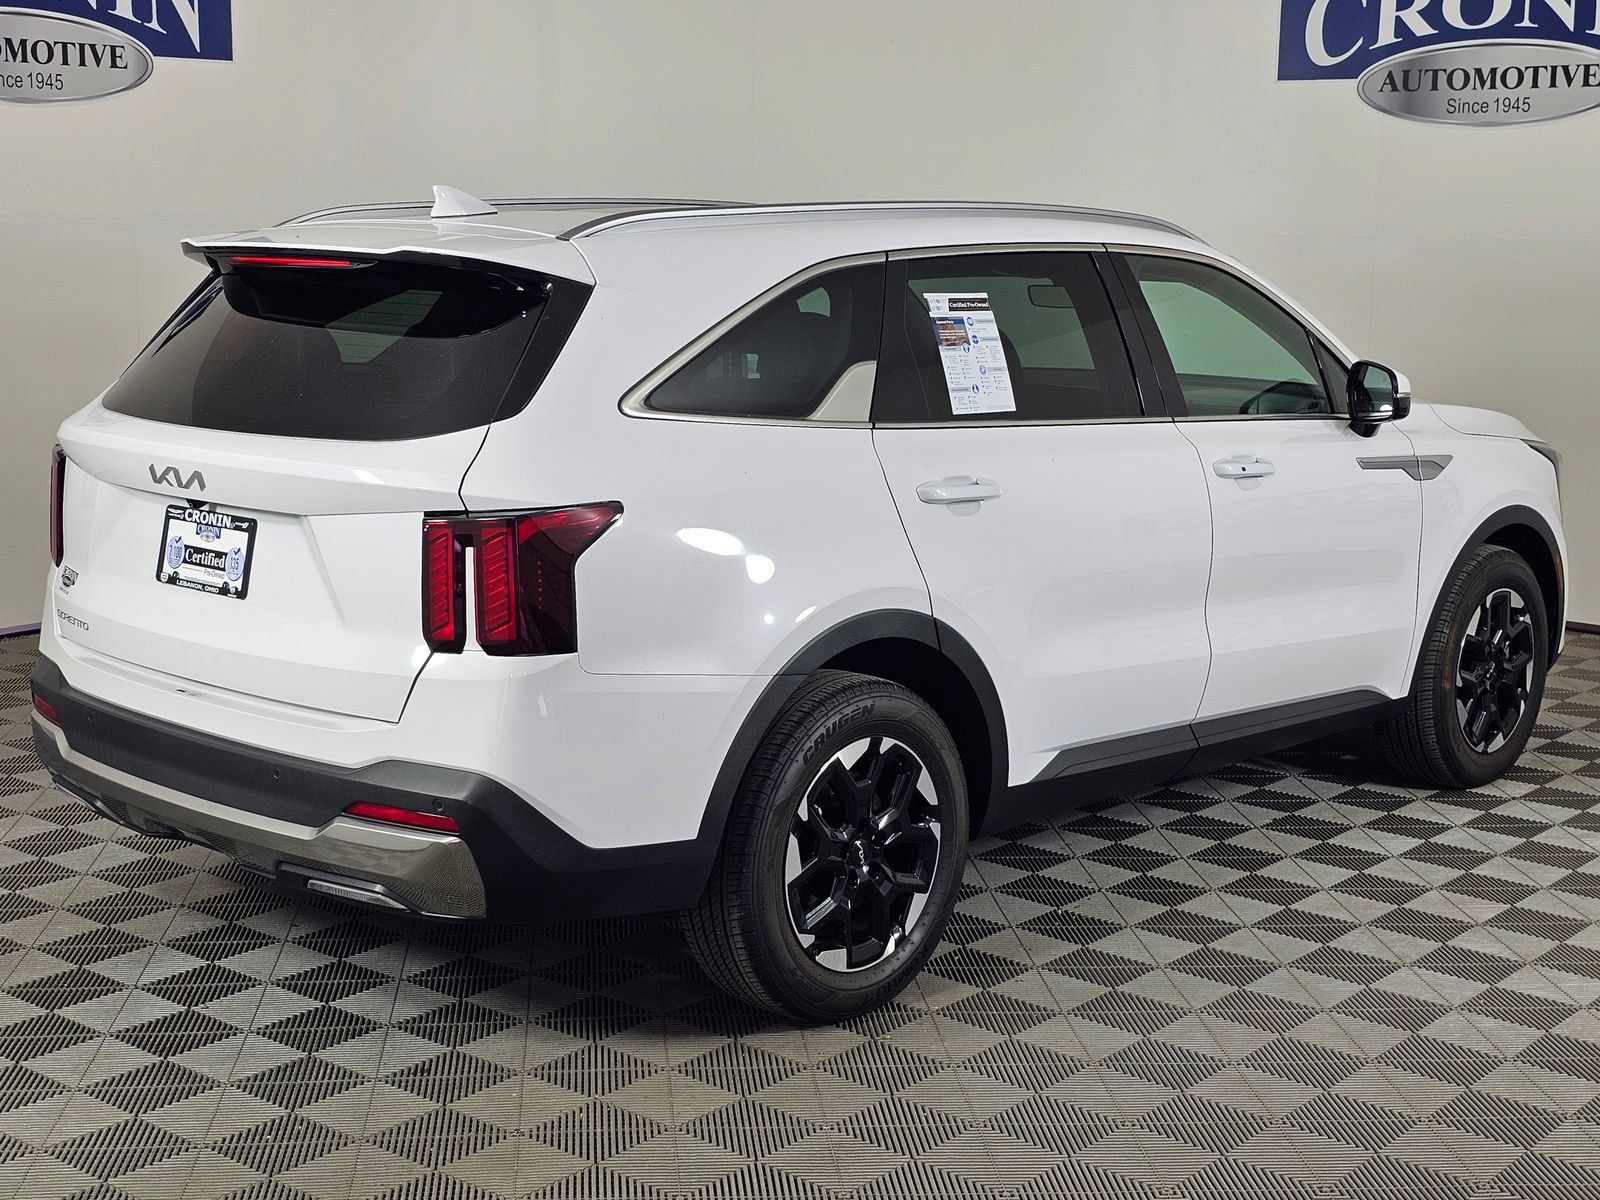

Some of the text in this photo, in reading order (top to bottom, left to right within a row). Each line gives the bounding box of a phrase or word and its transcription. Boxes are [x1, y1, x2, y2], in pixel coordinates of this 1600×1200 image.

[0, 36, 128, 70] MOTIVE
[27, 72, 64, 90] 1945
[1377, 63, 1600, 93] AUTOMOTIVE
[1446, 96, 1531, 114] Since 1945
[184, 508, 232, 528] CRONIN
[185, 548, 225, 568] Certified
[204, 585, 219, 593] OHIO
[802, 703, 876, 765] CRUGEN
